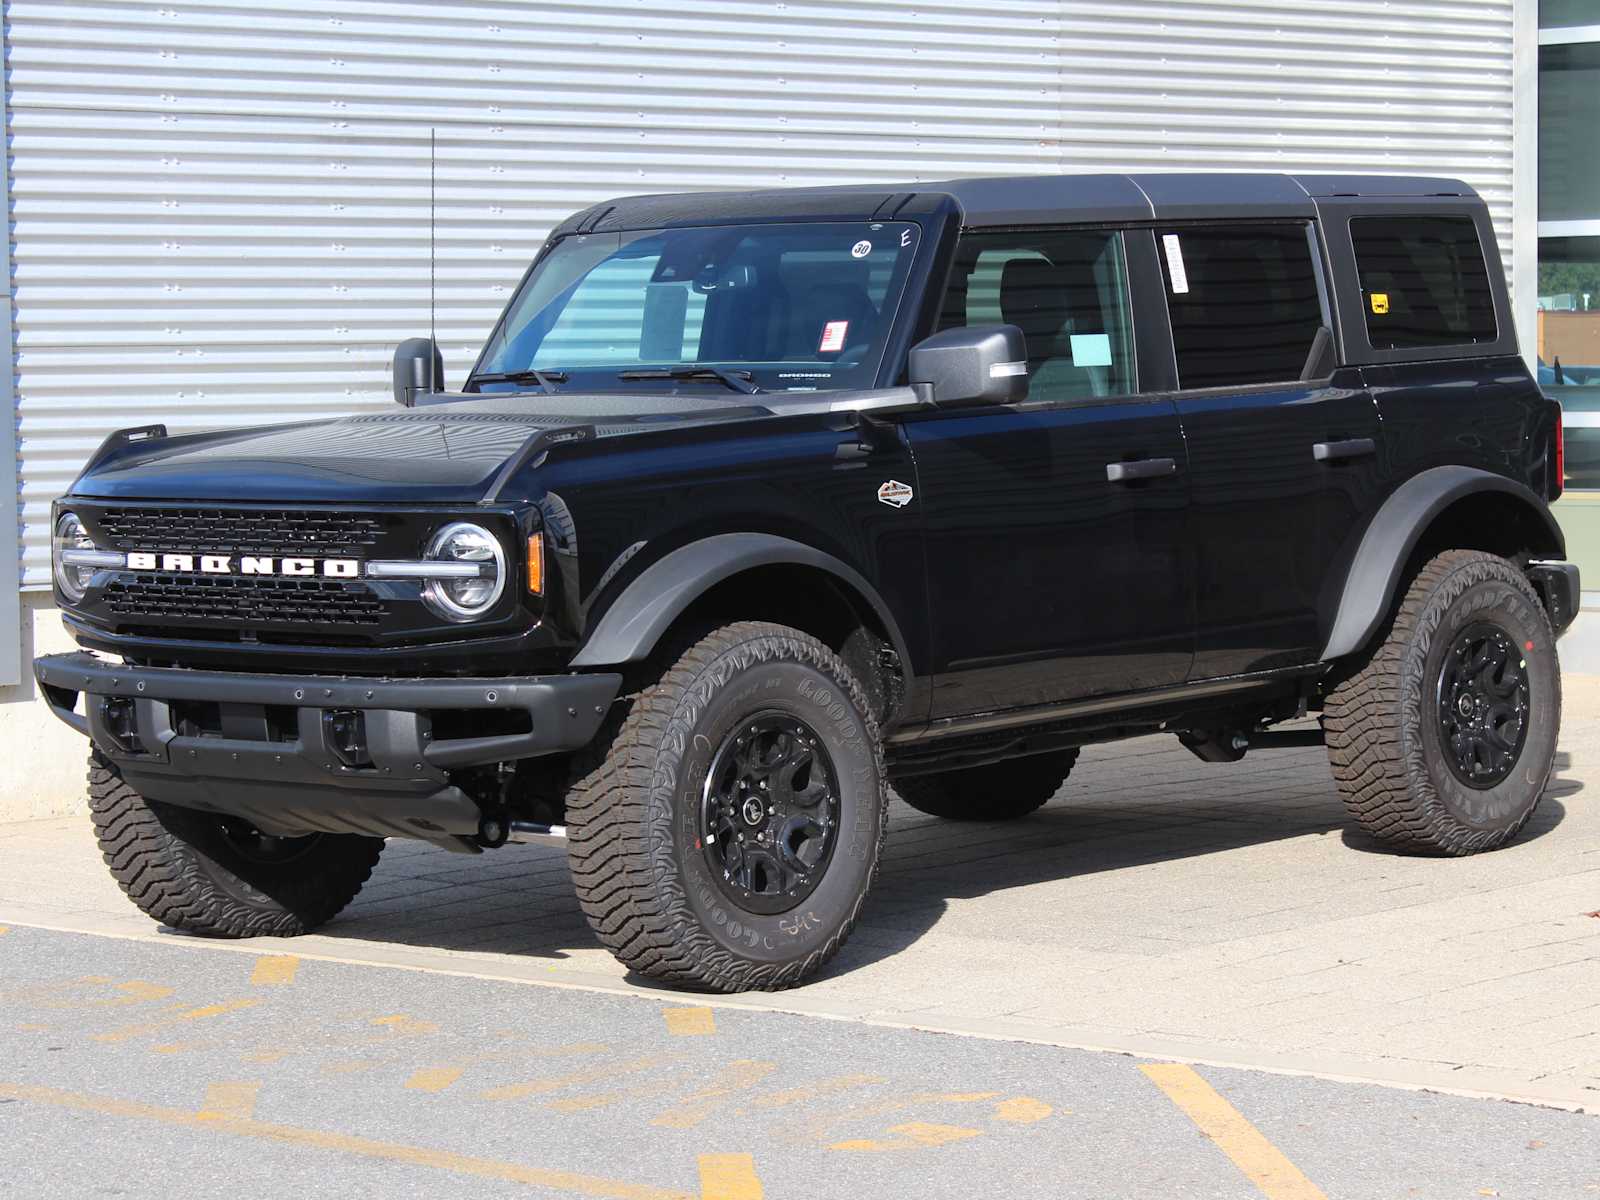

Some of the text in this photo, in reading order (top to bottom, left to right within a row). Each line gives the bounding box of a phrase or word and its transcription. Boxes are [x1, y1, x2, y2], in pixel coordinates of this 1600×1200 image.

[900, 228, 912, 247] E
[854, 243, 870, 255] 30
[127, 552, 359, 577] BRONCO
